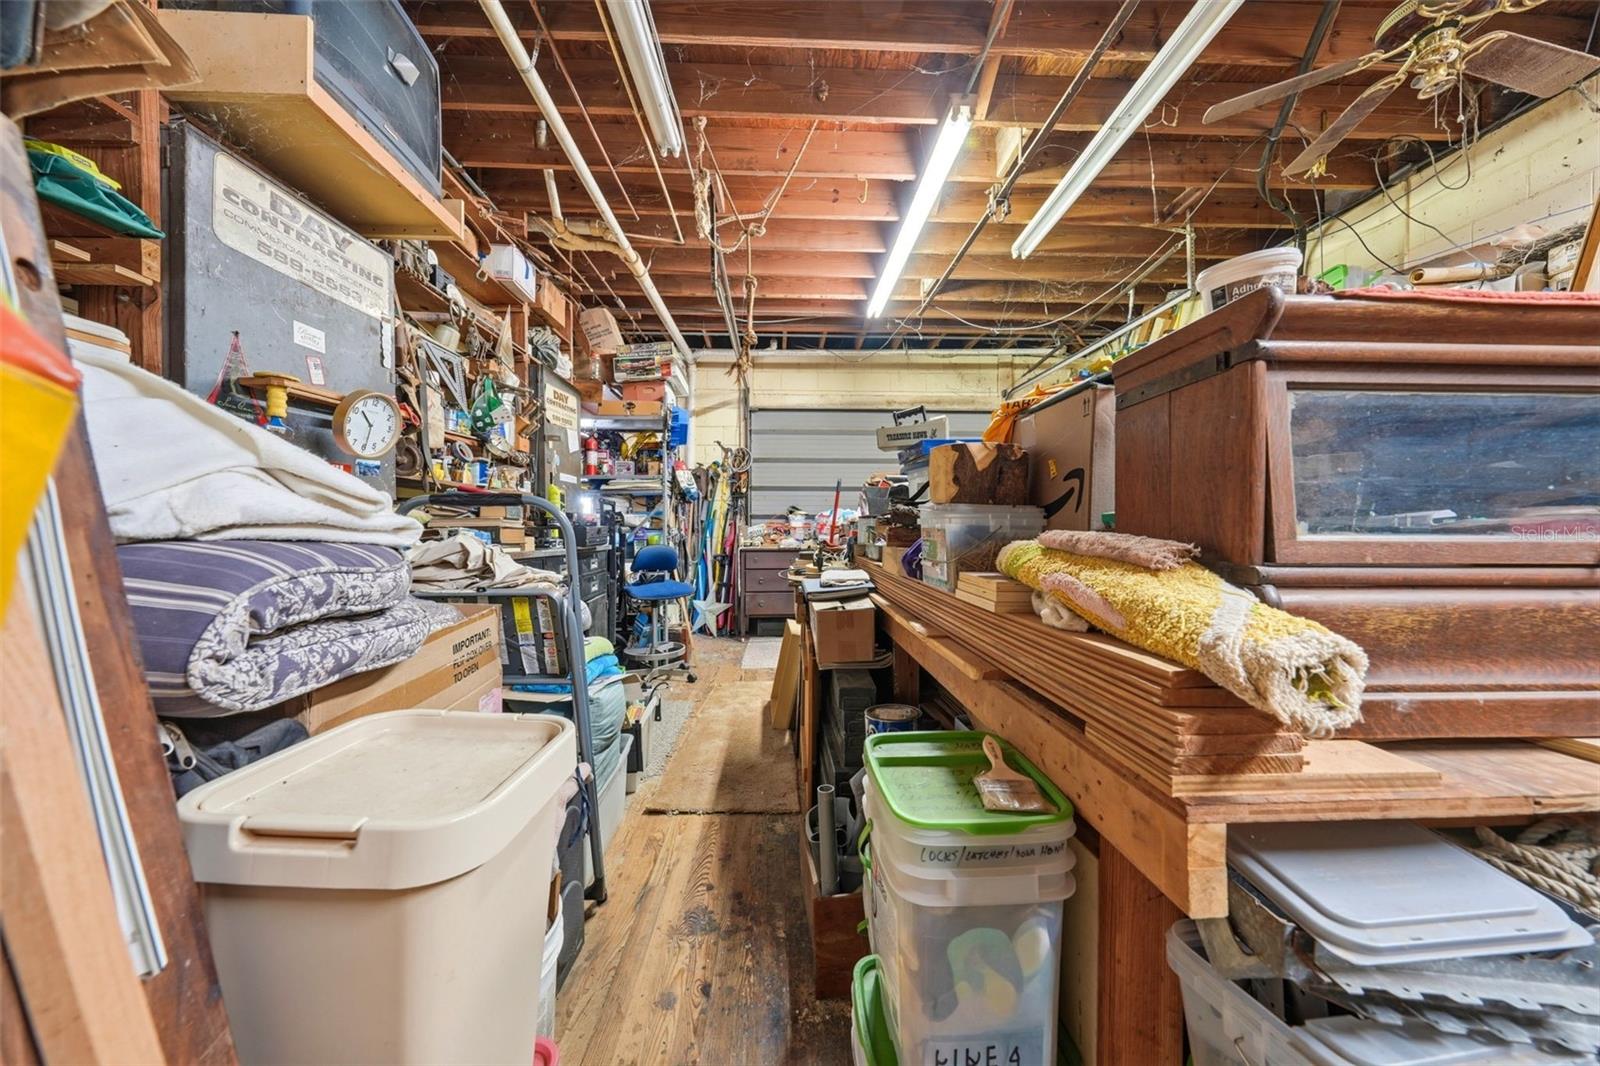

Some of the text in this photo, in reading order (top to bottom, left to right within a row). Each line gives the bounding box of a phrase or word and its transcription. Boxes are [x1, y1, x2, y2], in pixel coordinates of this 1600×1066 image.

[270, 190, 352, 254] DAY
[222, 187, 384, 288] CONTRACTING
[223, 208, 309, 260] COMMERCIAL
[553, 390, 569, 404] DAY
[362, 400, 369, 408] 11
[372, 399, 379, 408] 12
[352, 406, 360, 415] 10
[386, 414, 392, 422] 2
[352, 438, 358, 446] 7
[371, 442, 377, 450] 5
[360, 443, 366, 451] 6
[454, 661, 479, 684] TO OPEN
